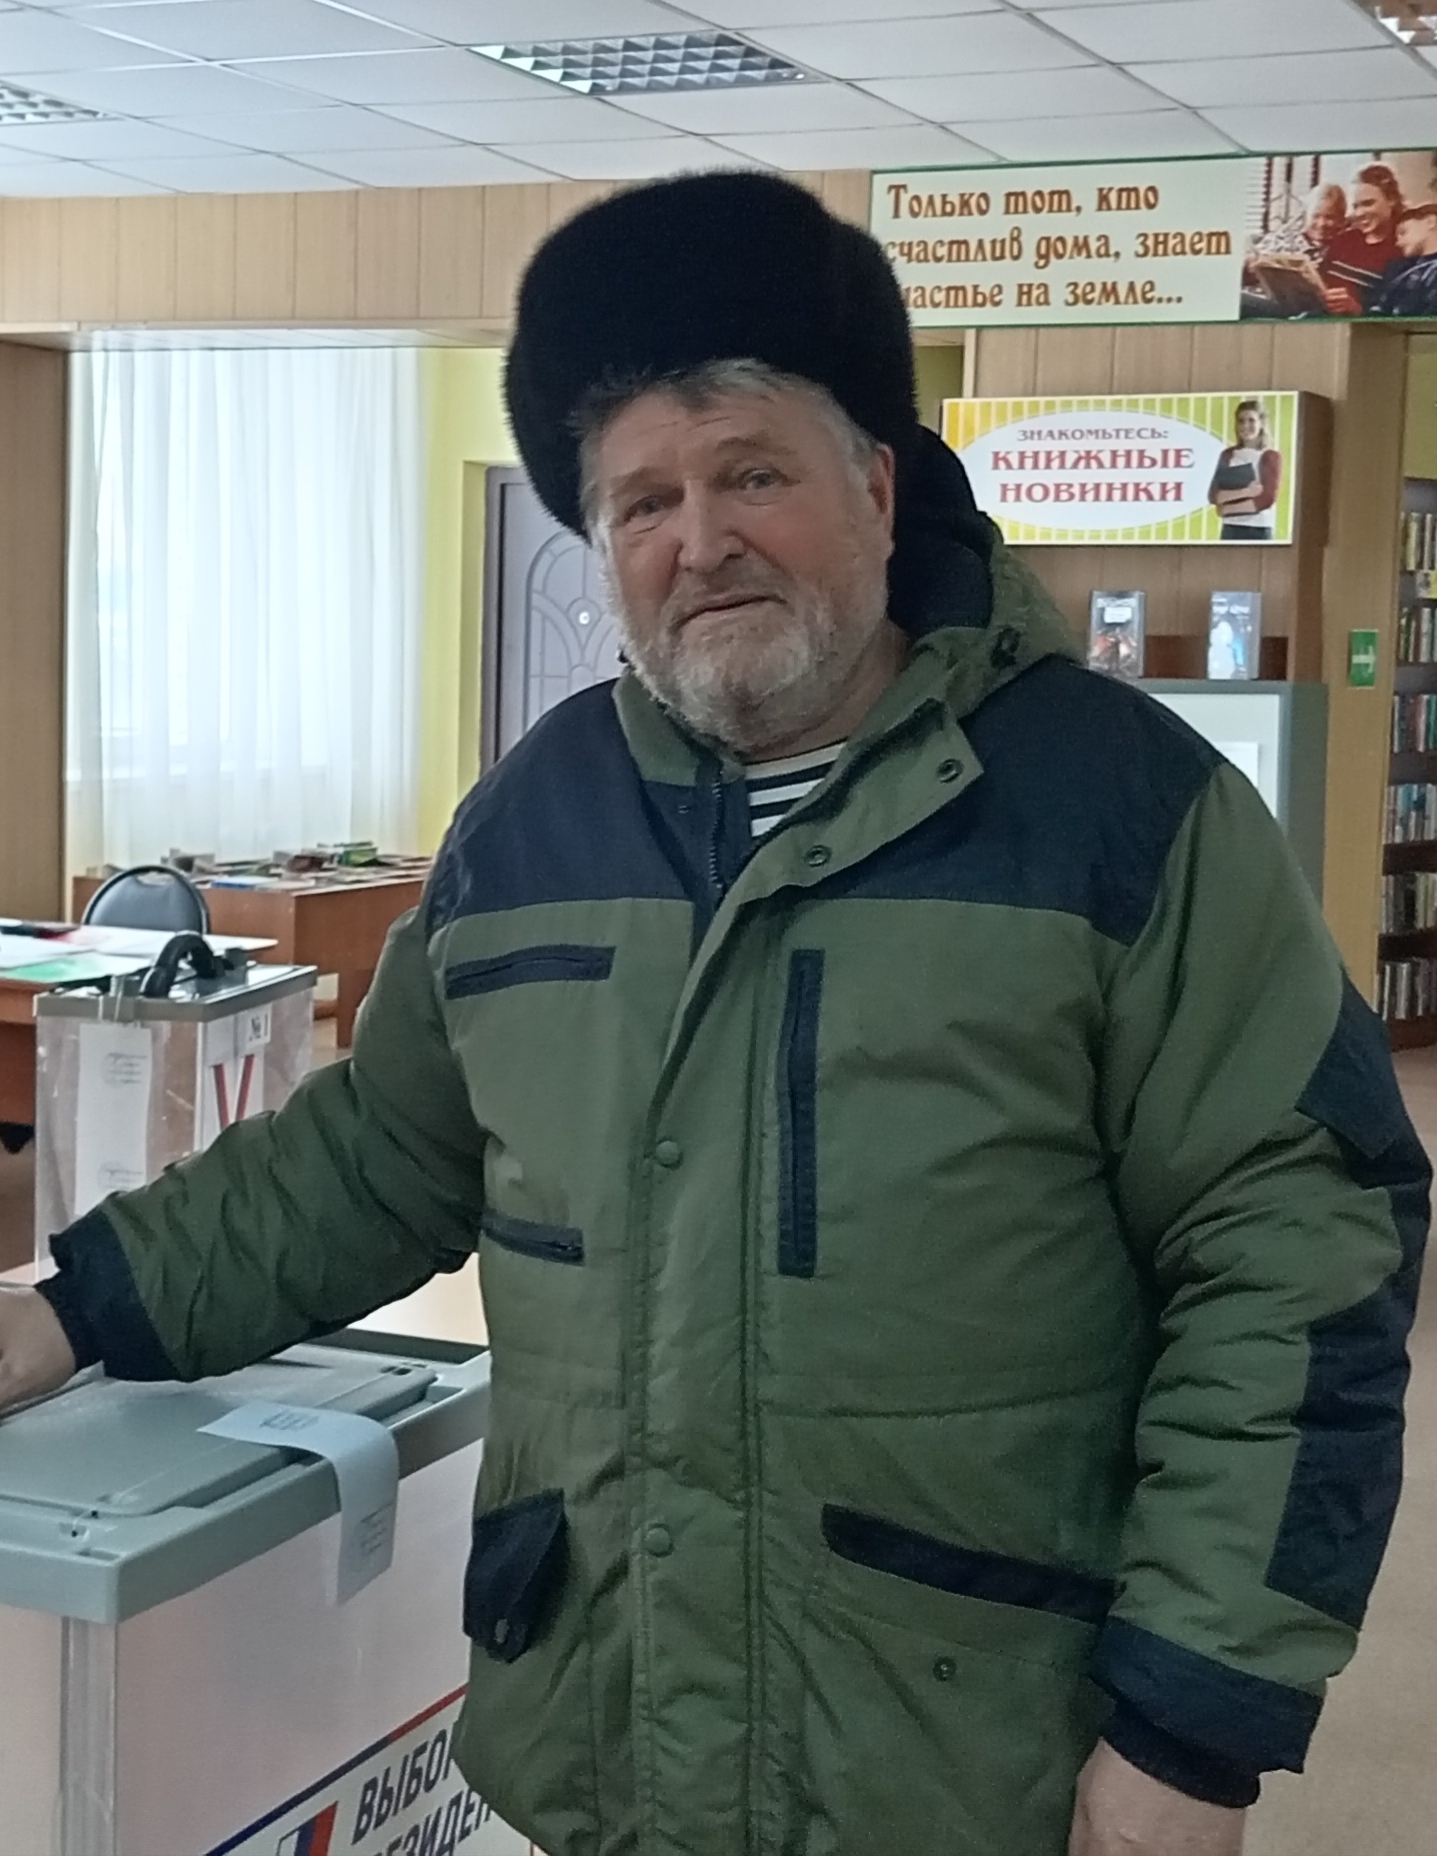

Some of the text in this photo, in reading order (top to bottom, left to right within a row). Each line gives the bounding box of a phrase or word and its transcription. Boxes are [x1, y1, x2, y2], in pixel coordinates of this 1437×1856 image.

[887, 184, 1160, 219] Только тот, кто
[884, 226, 1232, 270] счастлив дома, знает
[902, 279, 1183, 309] астье на земле...
[1017, 427, 1169, 442] ЗНАКОМЬТЕСЬ:
[991, 448, 1196, 471] КНИЖНЫЕ
[998, 481, 1184, 503] НОВИНКИ
[351, 1728, 451, 1846] ВЫБО
[373, 1787, 491, 1856] ЗИДЕ
